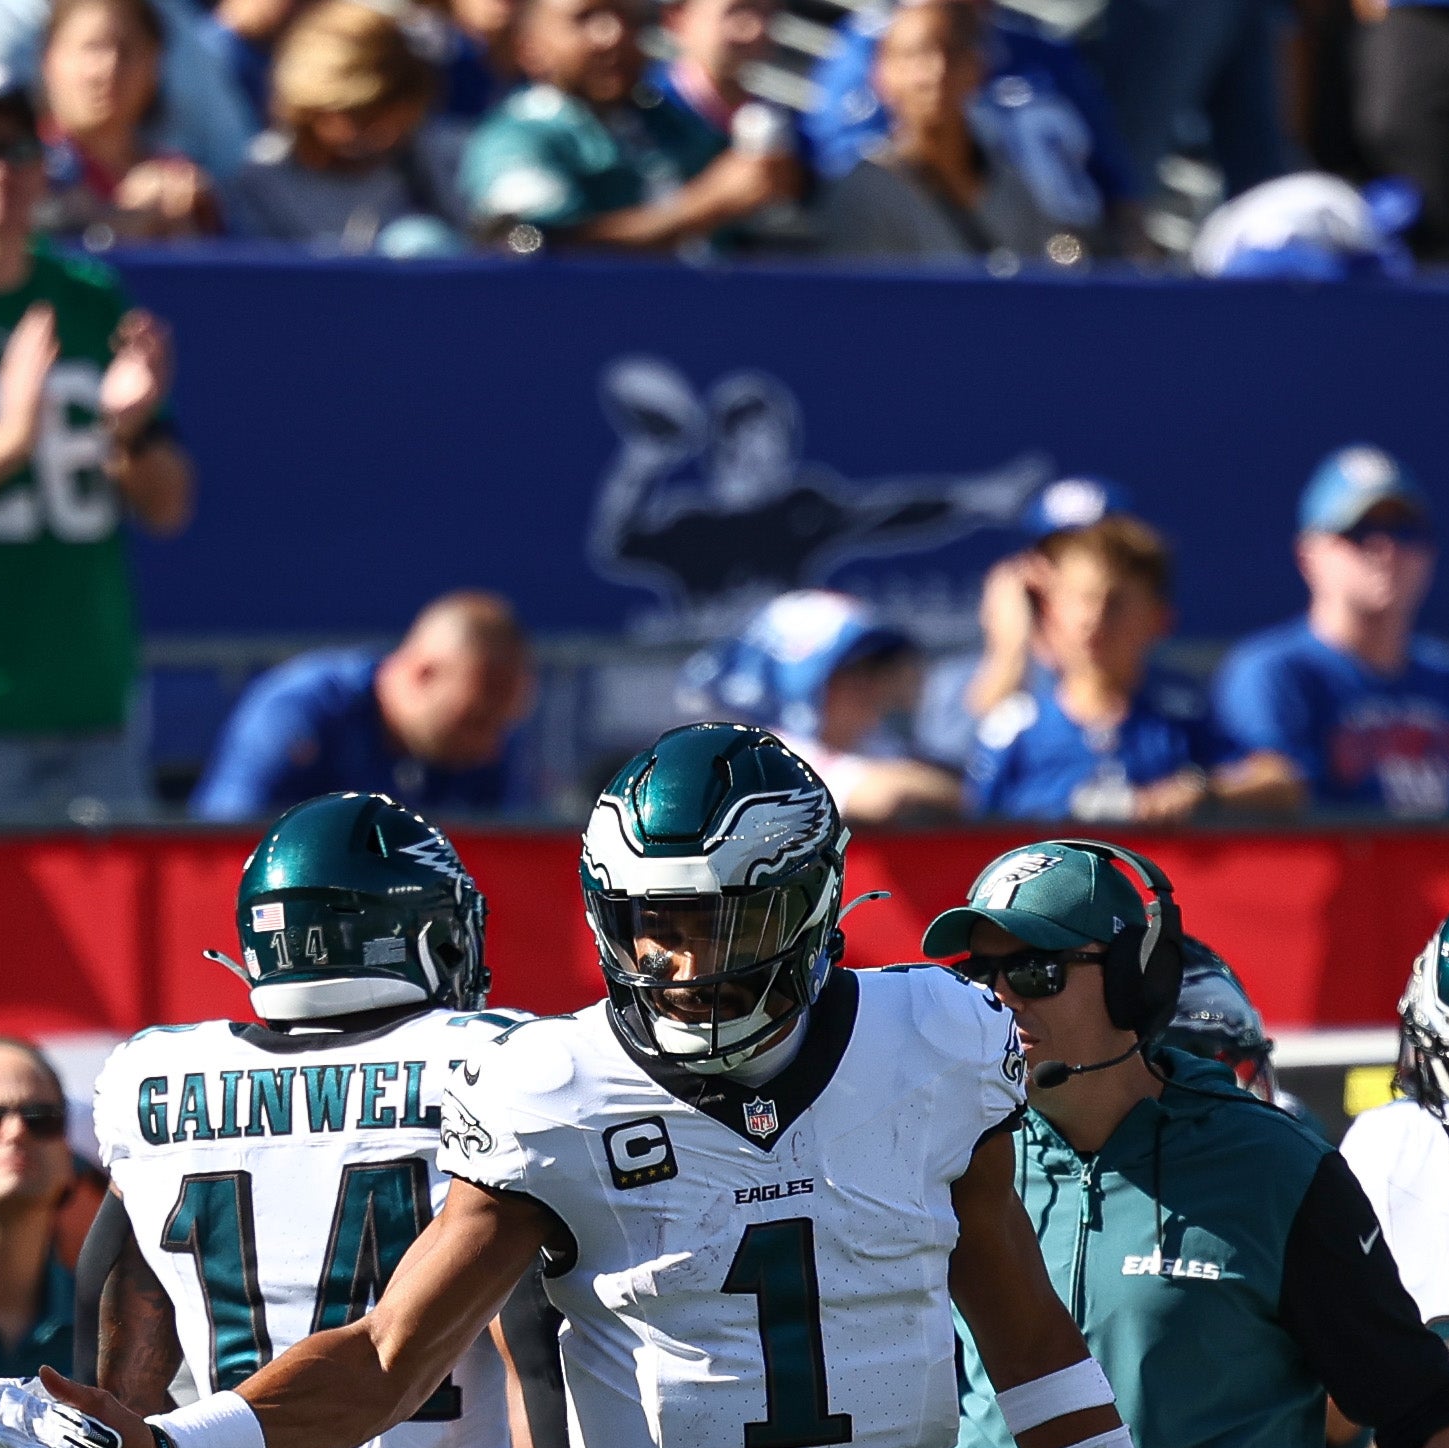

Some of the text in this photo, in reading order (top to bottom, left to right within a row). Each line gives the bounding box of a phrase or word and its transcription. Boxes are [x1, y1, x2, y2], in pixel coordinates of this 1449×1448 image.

[138, 1059, 466, 1146] GAINWEL
[750, 1114, 774, 1131] NFL
[609, 1121, 669, 1173] C
[732, 1177, 815, 1205] EAGLES
[1121, 1253, 1221, 1281] EAGLES
